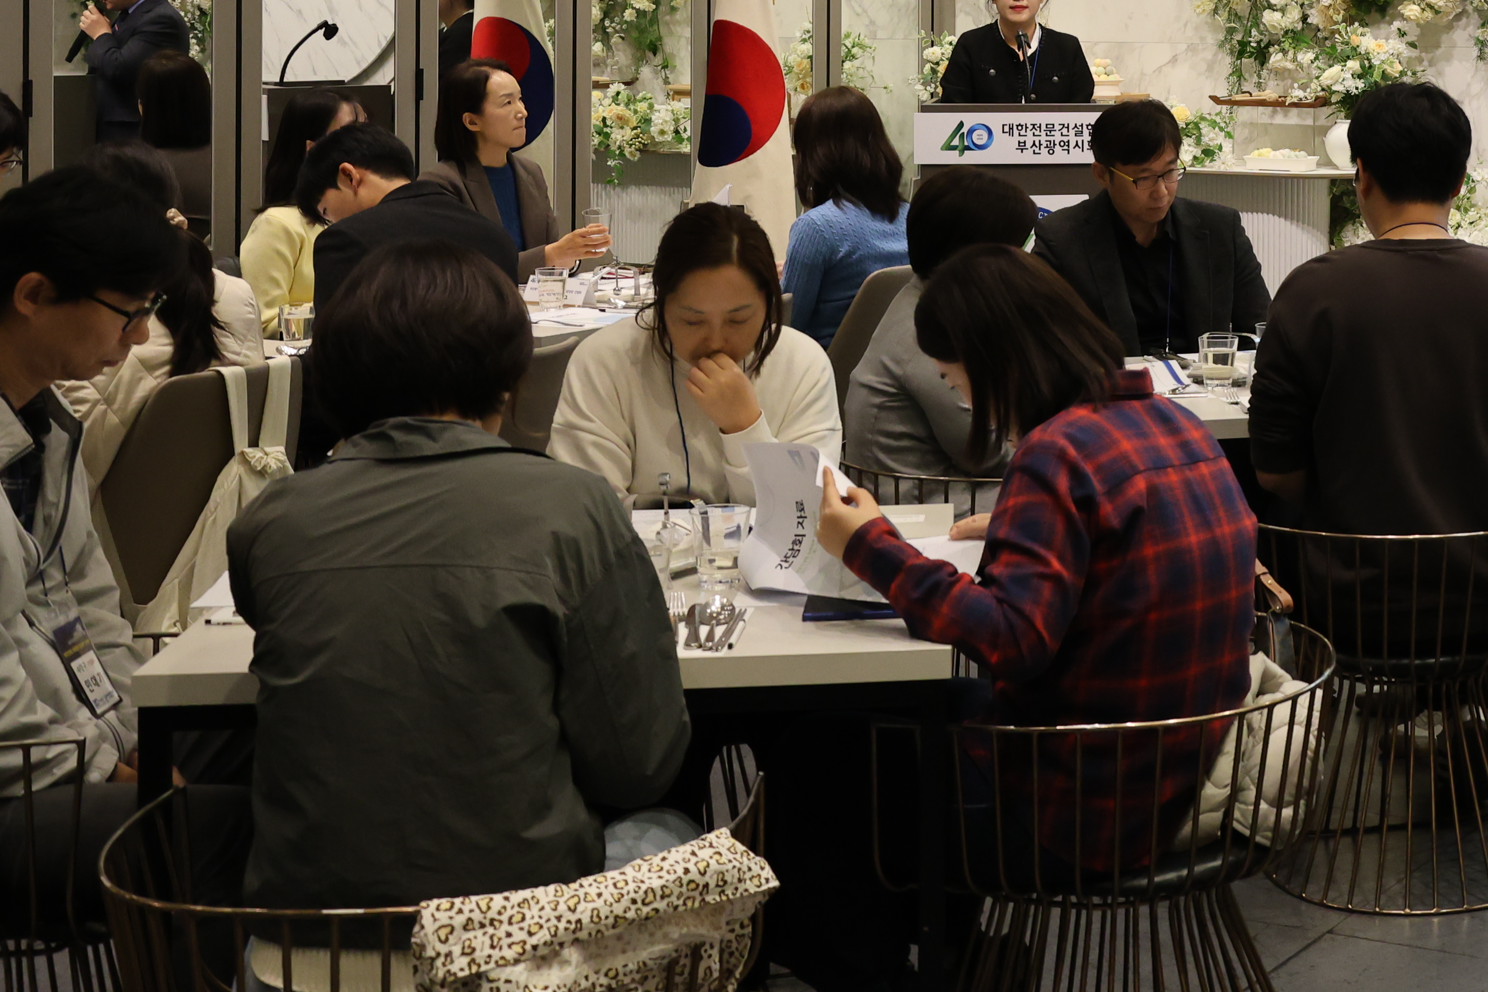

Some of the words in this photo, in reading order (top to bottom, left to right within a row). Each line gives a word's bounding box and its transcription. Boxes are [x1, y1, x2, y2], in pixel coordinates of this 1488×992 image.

[940, 120, 995, 158] 40
[775, 533, 807, 570] 간담회
[795, 499, 808, 530] 자료
